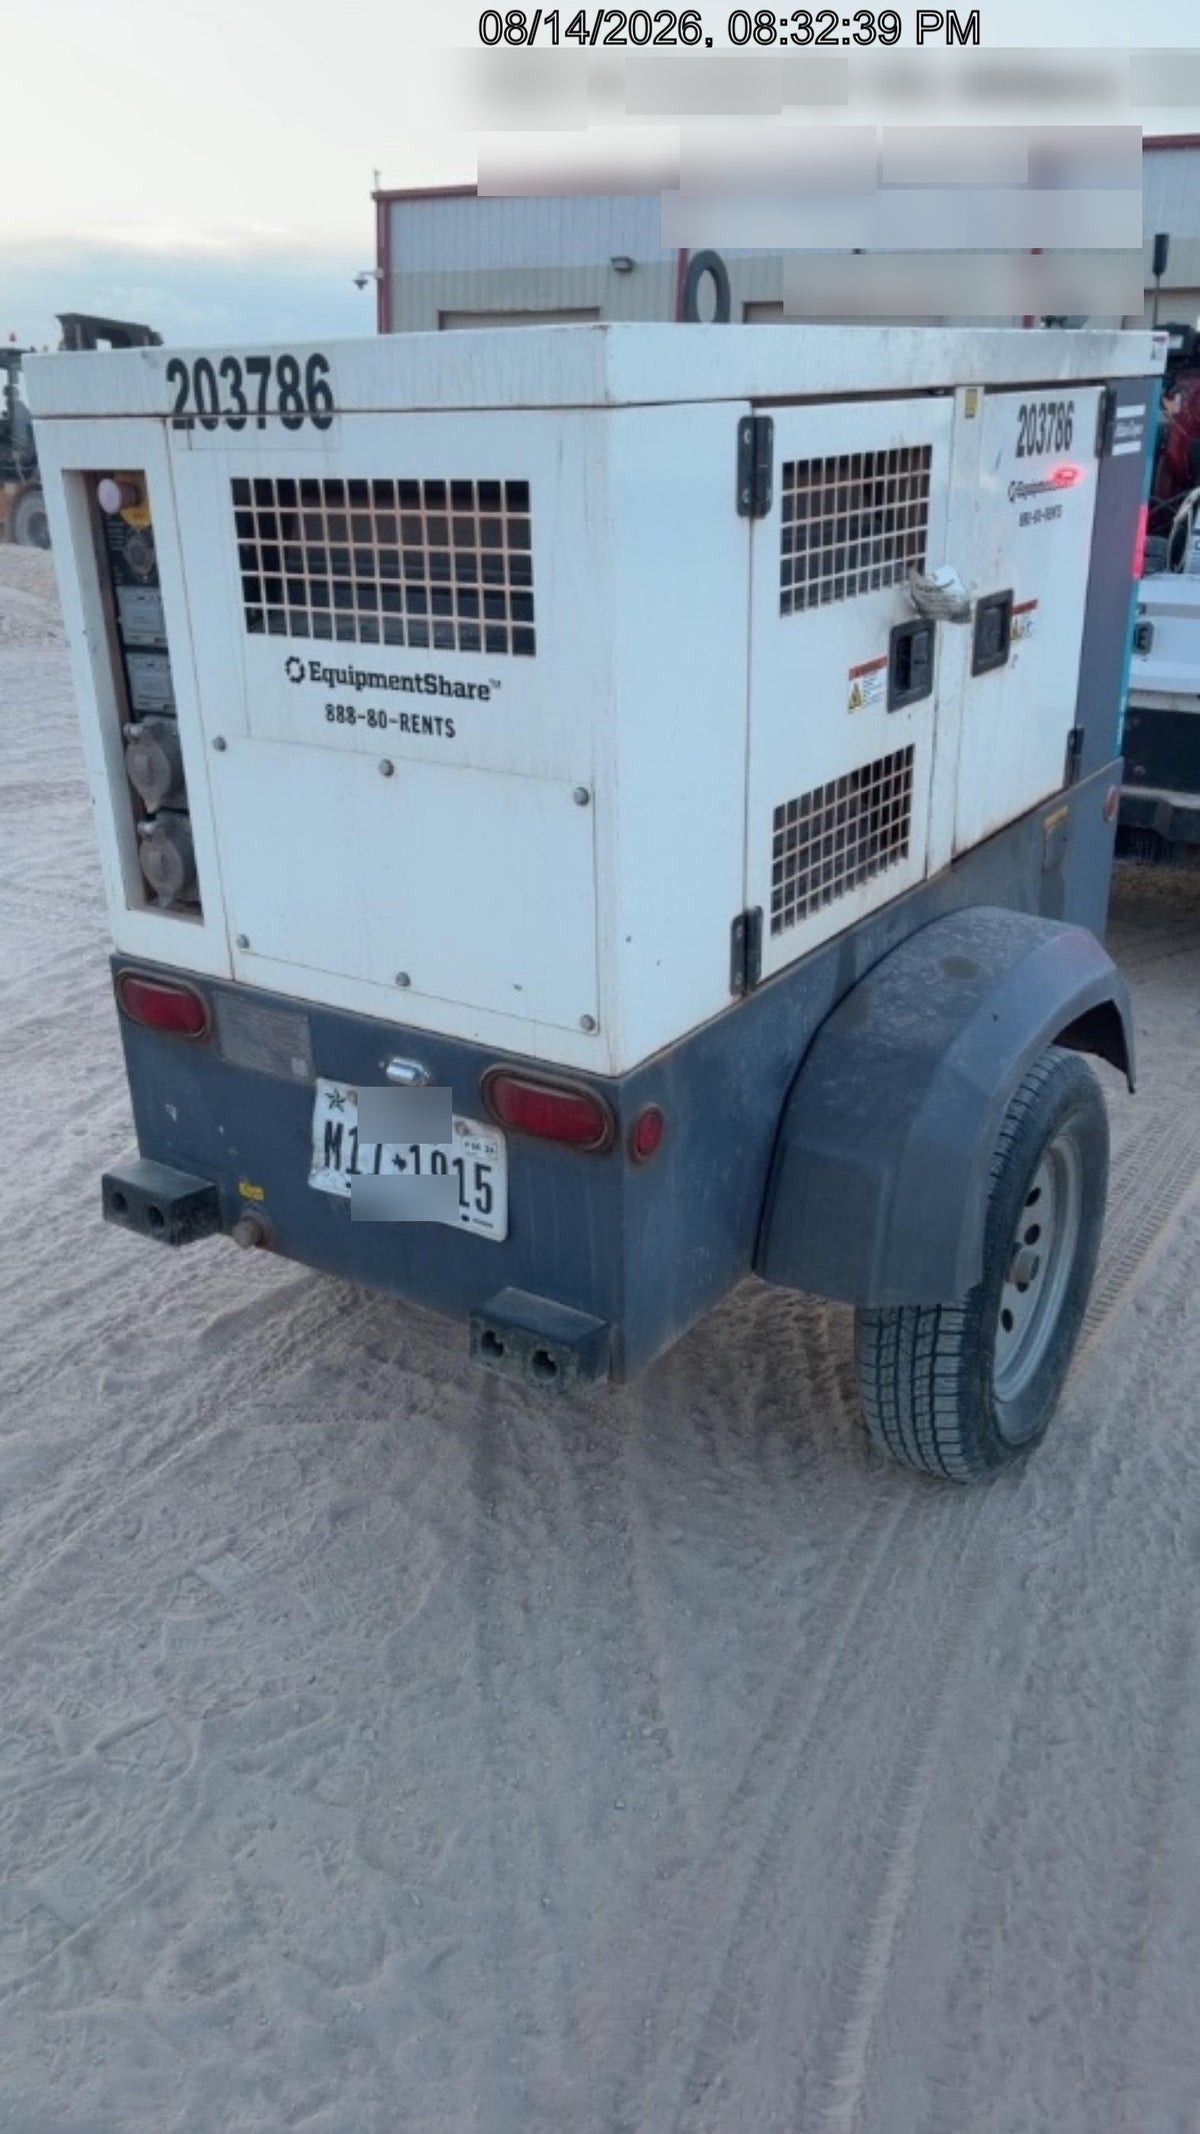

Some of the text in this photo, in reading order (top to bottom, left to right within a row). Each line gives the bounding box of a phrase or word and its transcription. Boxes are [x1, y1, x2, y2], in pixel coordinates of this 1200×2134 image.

[166, 353, 333, 431] 203786
[1015, 400, 1075, 458] 203786
[308, 660, 490, 701] EquipmentShare
[324, 703, 456, 738] 888-80-RENTS
